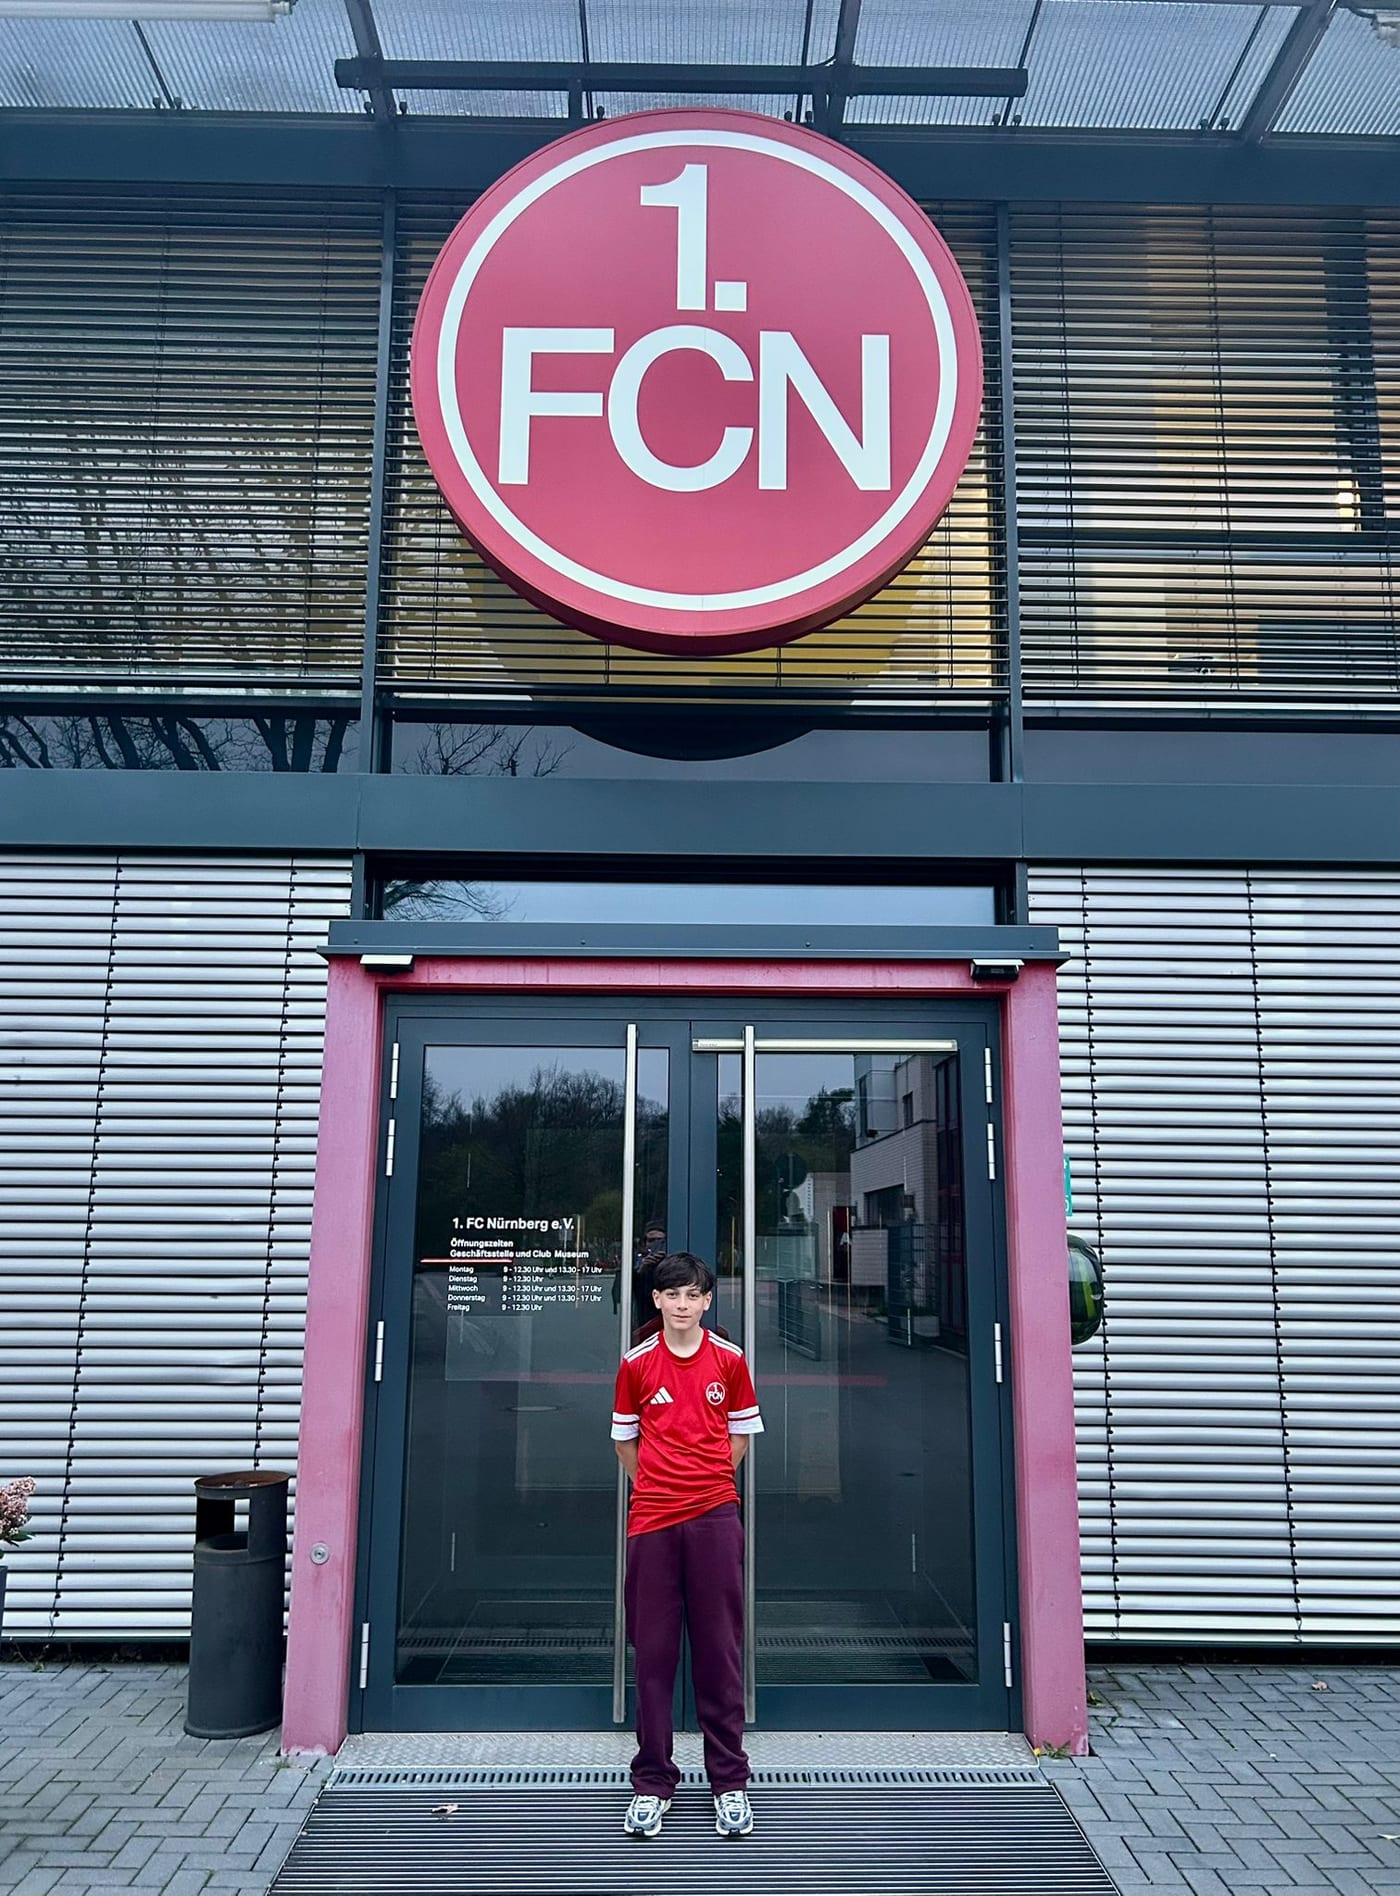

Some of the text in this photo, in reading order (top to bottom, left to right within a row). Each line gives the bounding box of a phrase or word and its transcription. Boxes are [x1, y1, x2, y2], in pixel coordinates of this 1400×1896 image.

[640, 163, 747, 312] 1.
[498, 325, 891, 492] FCN
[452, 1217, 575, 1232] 1. FC Nürnberg e.V.
[450, 1237, 514, 1248] Öffnungszeiten
[450, 1249, 589, 1258] Geschäftsstelle und Club Museum
[449, 1266, 474, 1274] Montag
[449, 1275, 477, 1283] Dienstag
[447, 1294, 486, 1302] Donnerstag
[447, 1304, 470, 1312] Freitag
[708, 1391, 723, 1400] FCN
